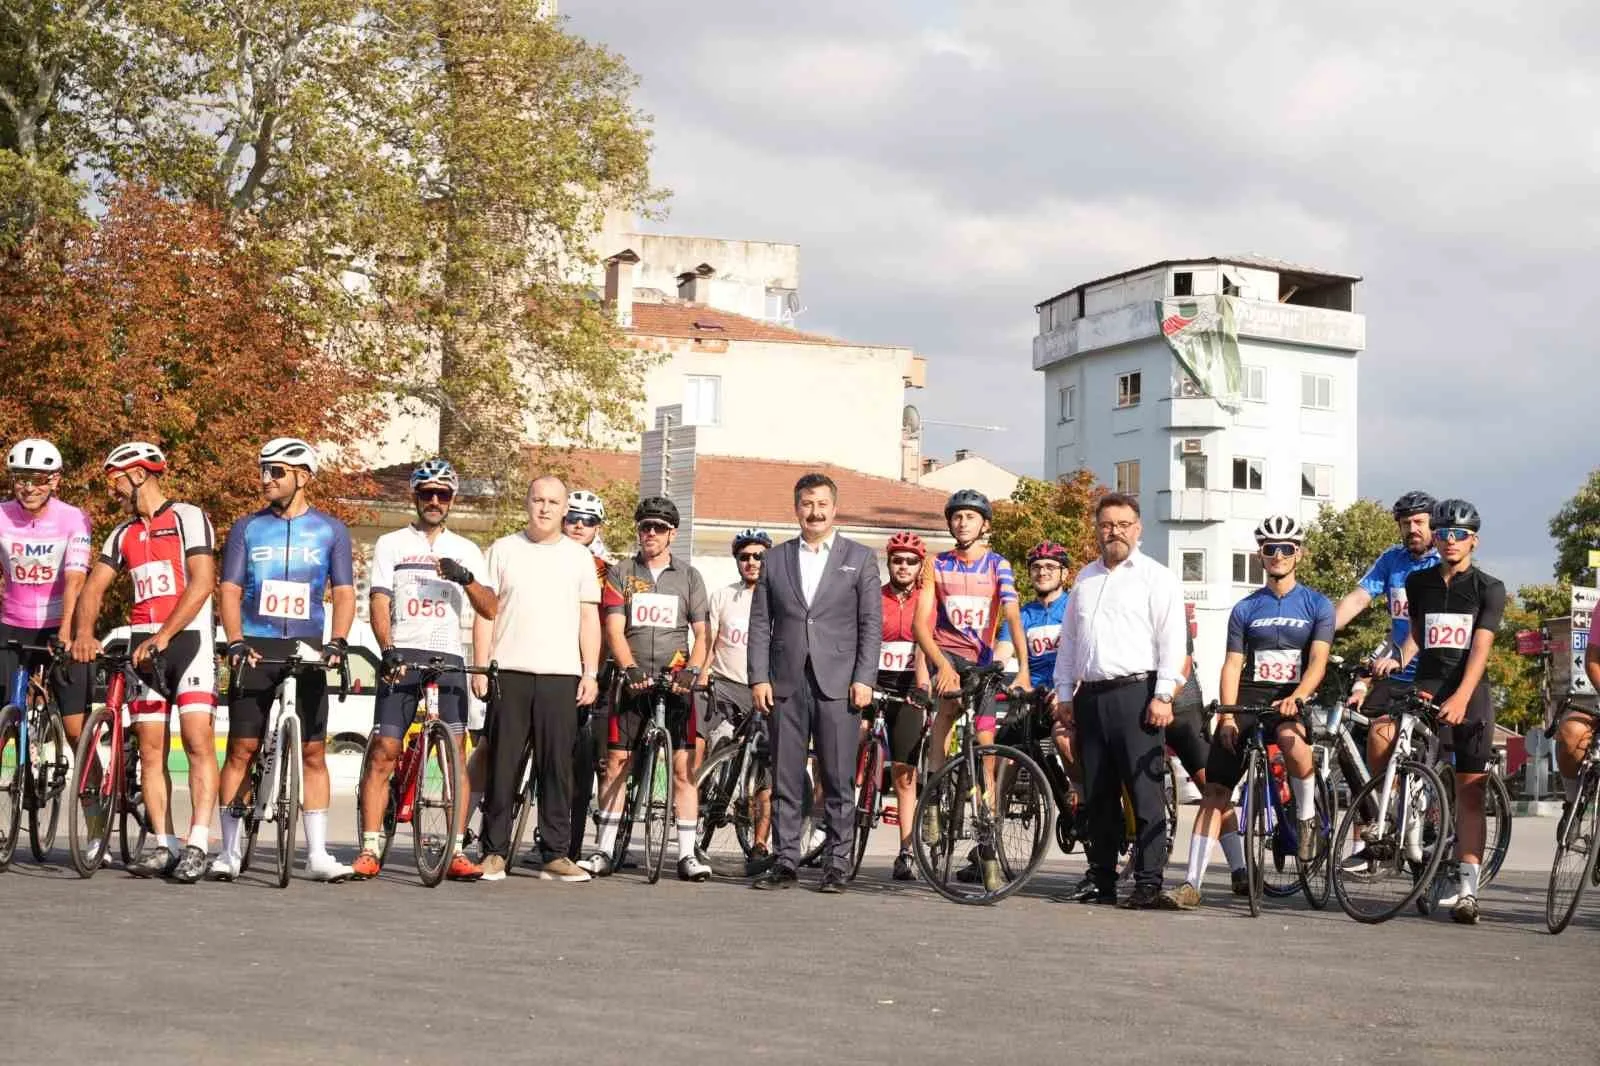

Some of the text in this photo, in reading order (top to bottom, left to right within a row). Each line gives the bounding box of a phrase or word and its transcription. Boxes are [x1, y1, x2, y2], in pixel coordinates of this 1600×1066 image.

[12, 542, 54, 556] RMK
[15, 565, 53, 580] 045
[137, 574, 170, 598] 013
[266, 594, 305, 615] 018
[407, 598, 446, 617] 056
[636, 605, 672, 624] 002
[951, 609, 984, 626] 051
[1249, 616, 1310, 628] GIANT
[1428, 626, 1467, 645] 020
[883, 652, 915, 669] 012
[1259, 662, 1297, 680] 033
